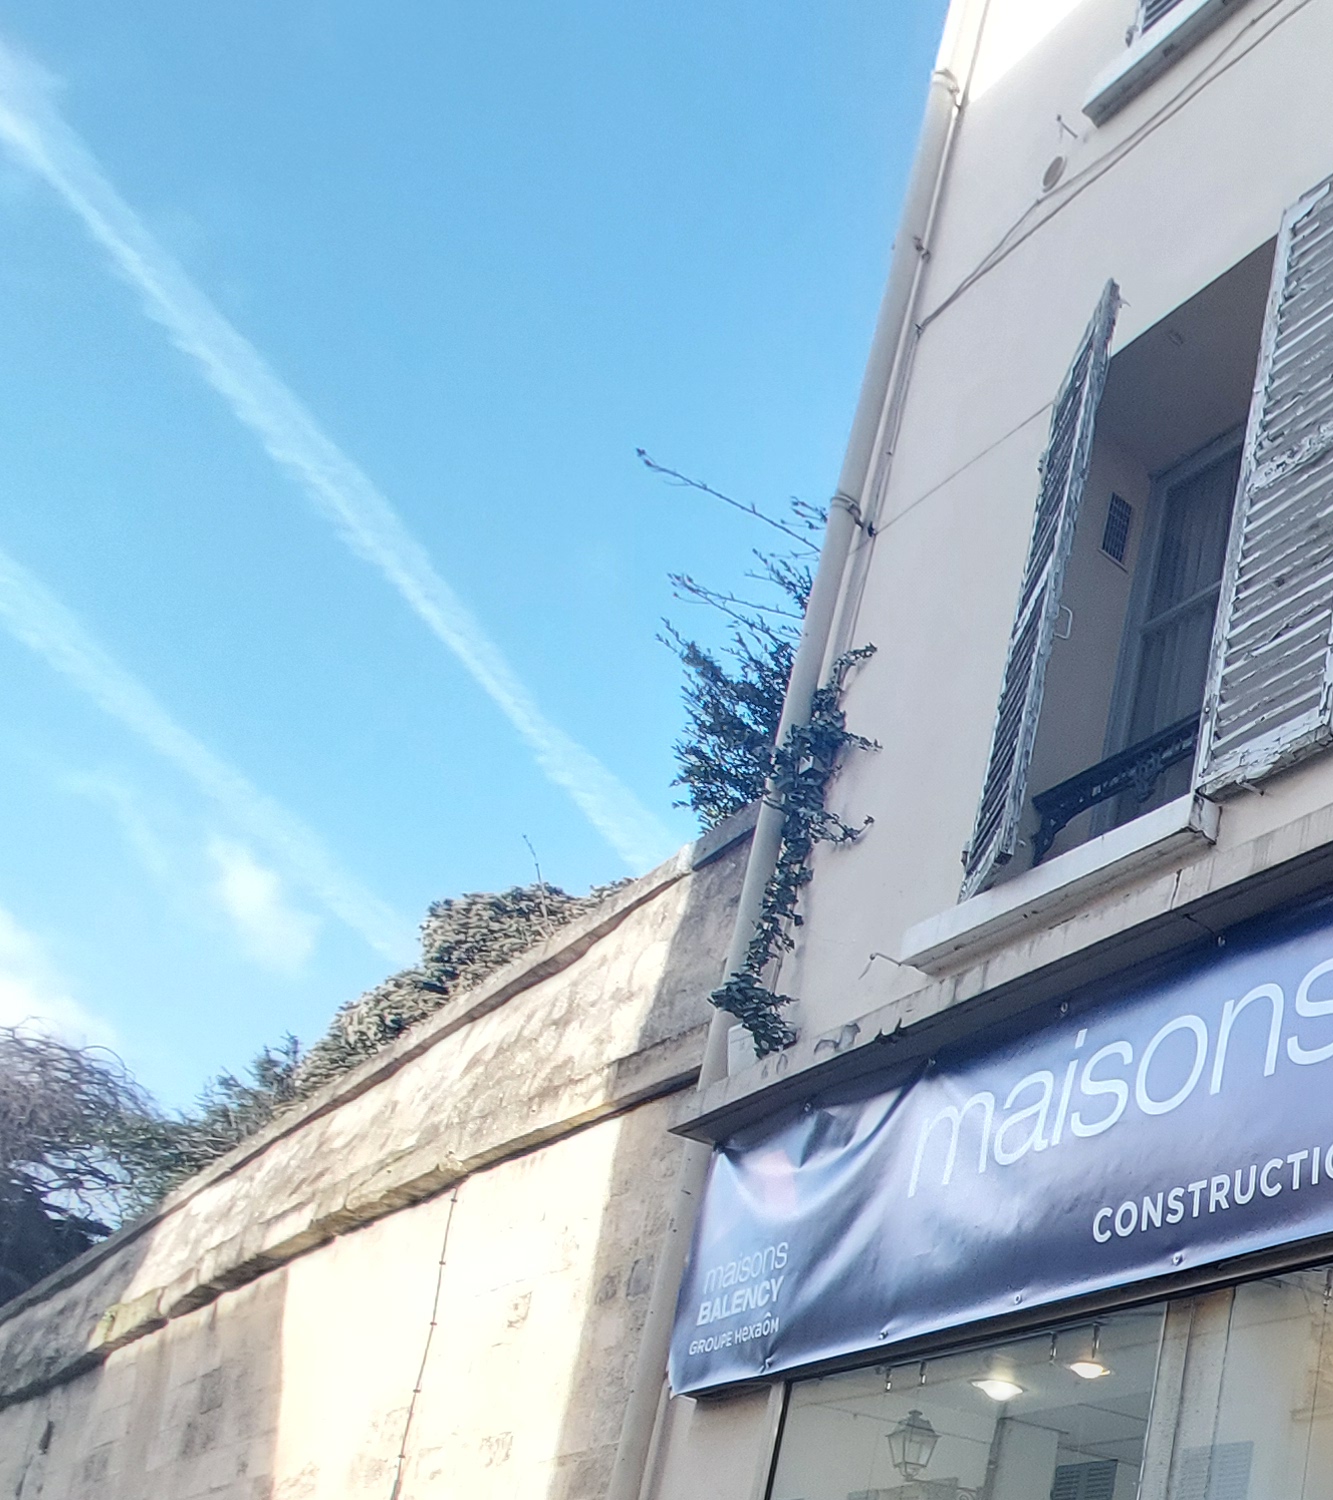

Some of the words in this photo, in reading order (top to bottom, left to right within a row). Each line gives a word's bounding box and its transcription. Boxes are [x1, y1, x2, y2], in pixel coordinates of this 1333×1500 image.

[704, 1242, 788, 1294] maisons
[696, 1276, 784, 1326] BALENCY
[689, 1332, 732, 1355] GROUPE
